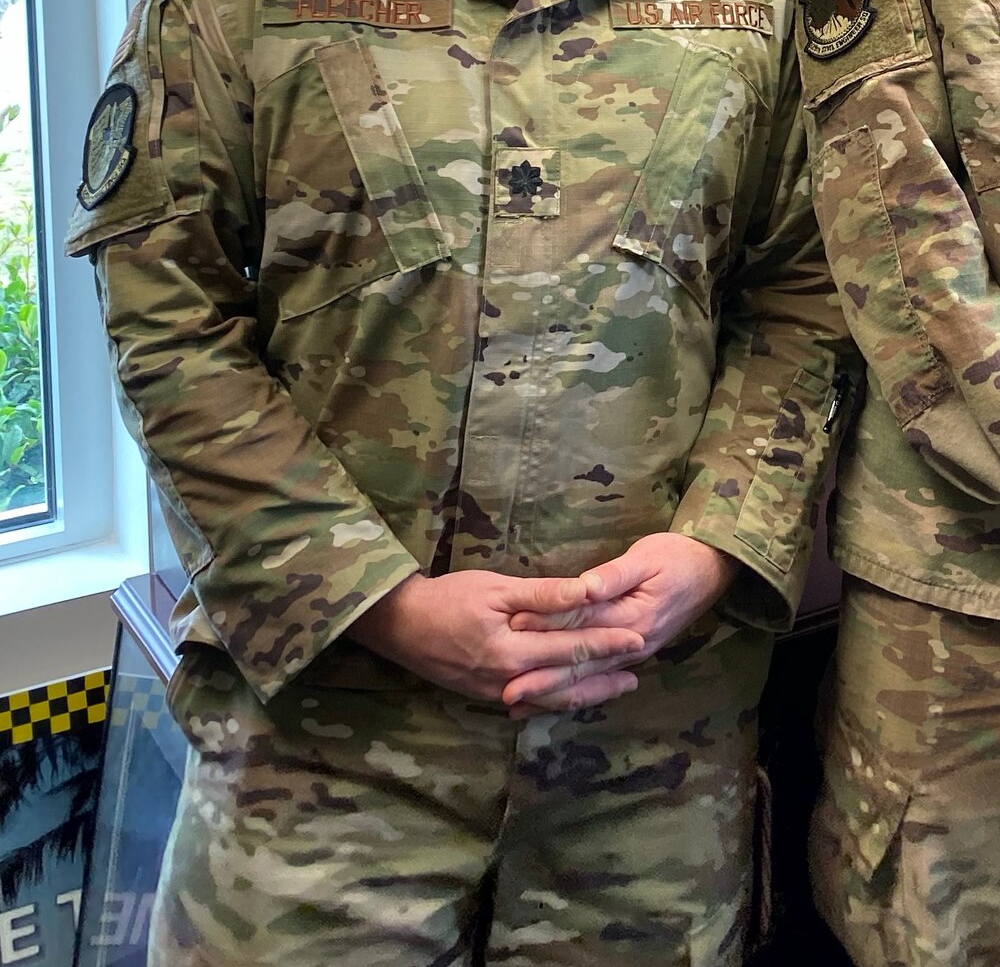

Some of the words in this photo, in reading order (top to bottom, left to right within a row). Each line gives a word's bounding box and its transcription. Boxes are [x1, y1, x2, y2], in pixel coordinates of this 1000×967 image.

[625, 2, 662, 25] U.S.
[670, 2, 702, 24] AIR
[709, 3, 766, 30] FORCE
